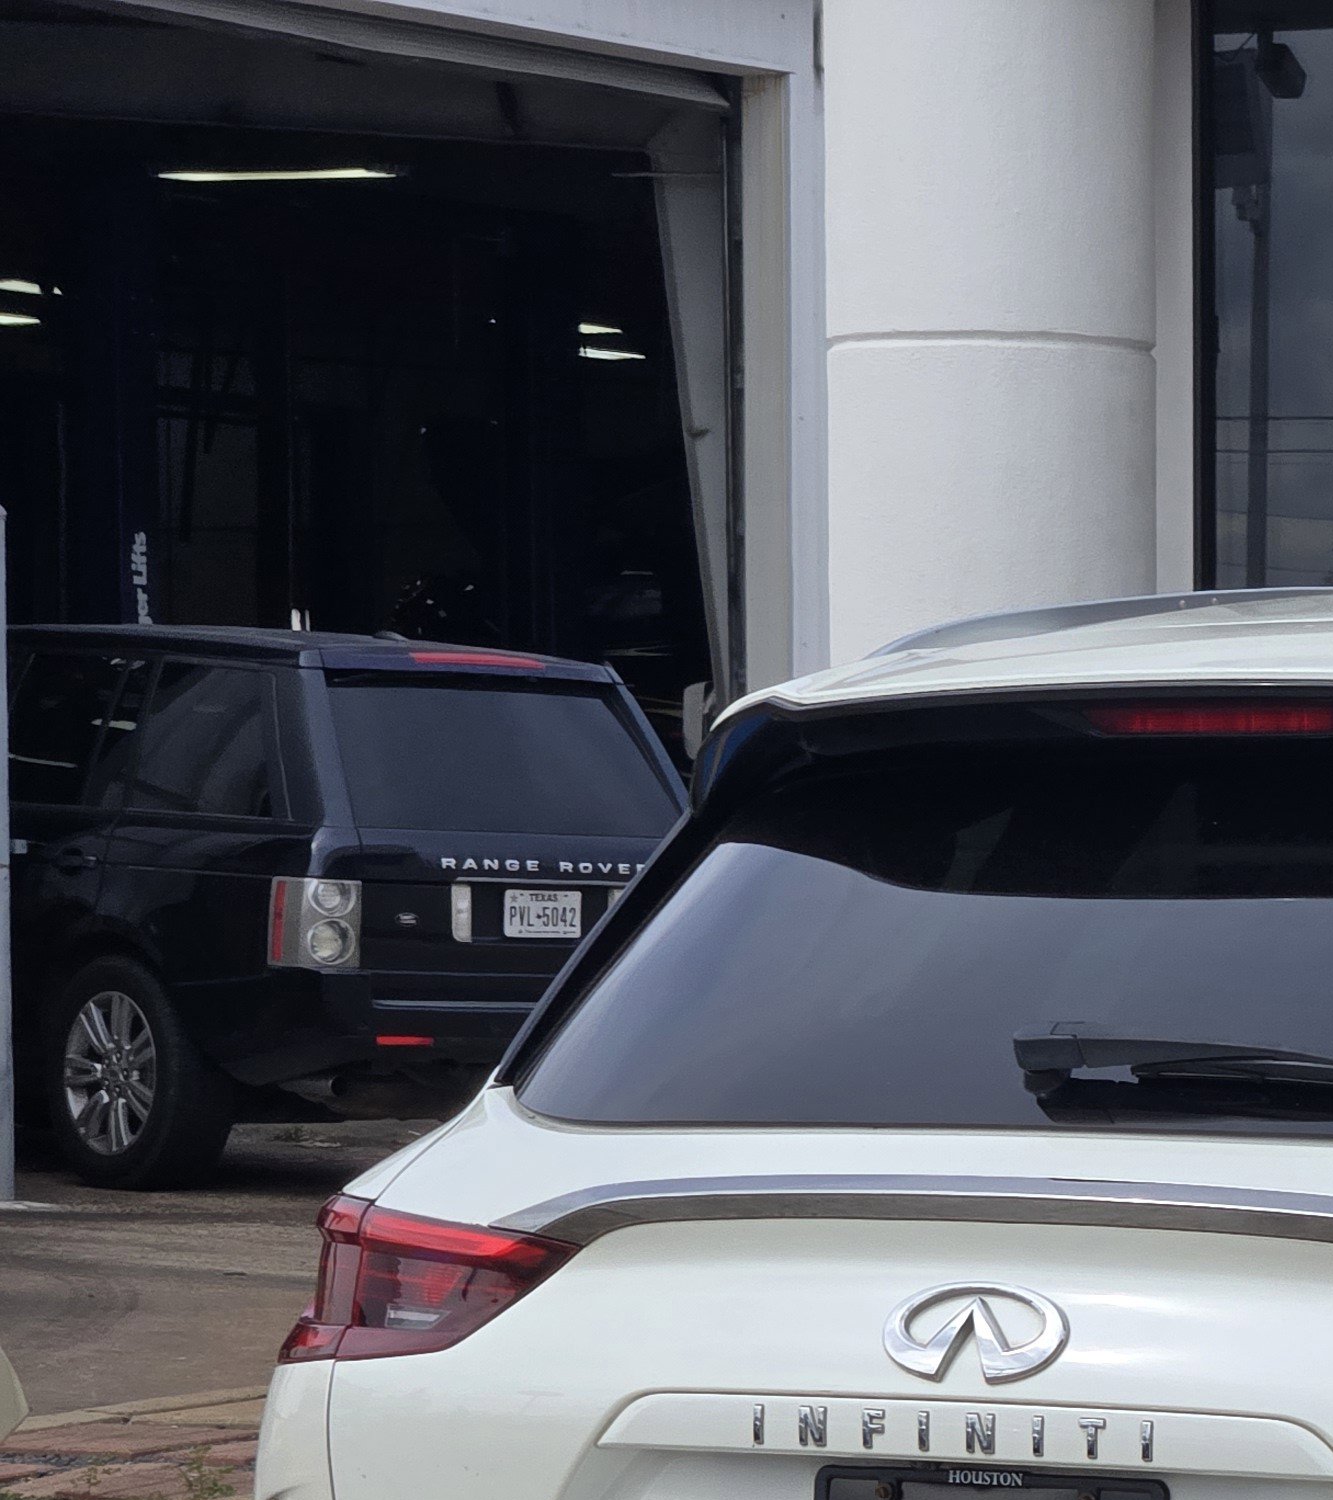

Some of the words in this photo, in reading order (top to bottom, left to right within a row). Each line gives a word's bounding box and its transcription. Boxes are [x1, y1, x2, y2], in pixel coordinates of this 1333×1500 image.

[440, 857, 540, 872] RANGE
[529, 893, 559, 902] TEXAS
[752, 1403, 1154, 1463] INFINITI
[948, 1469, 1023, 1487] HOUSTON
